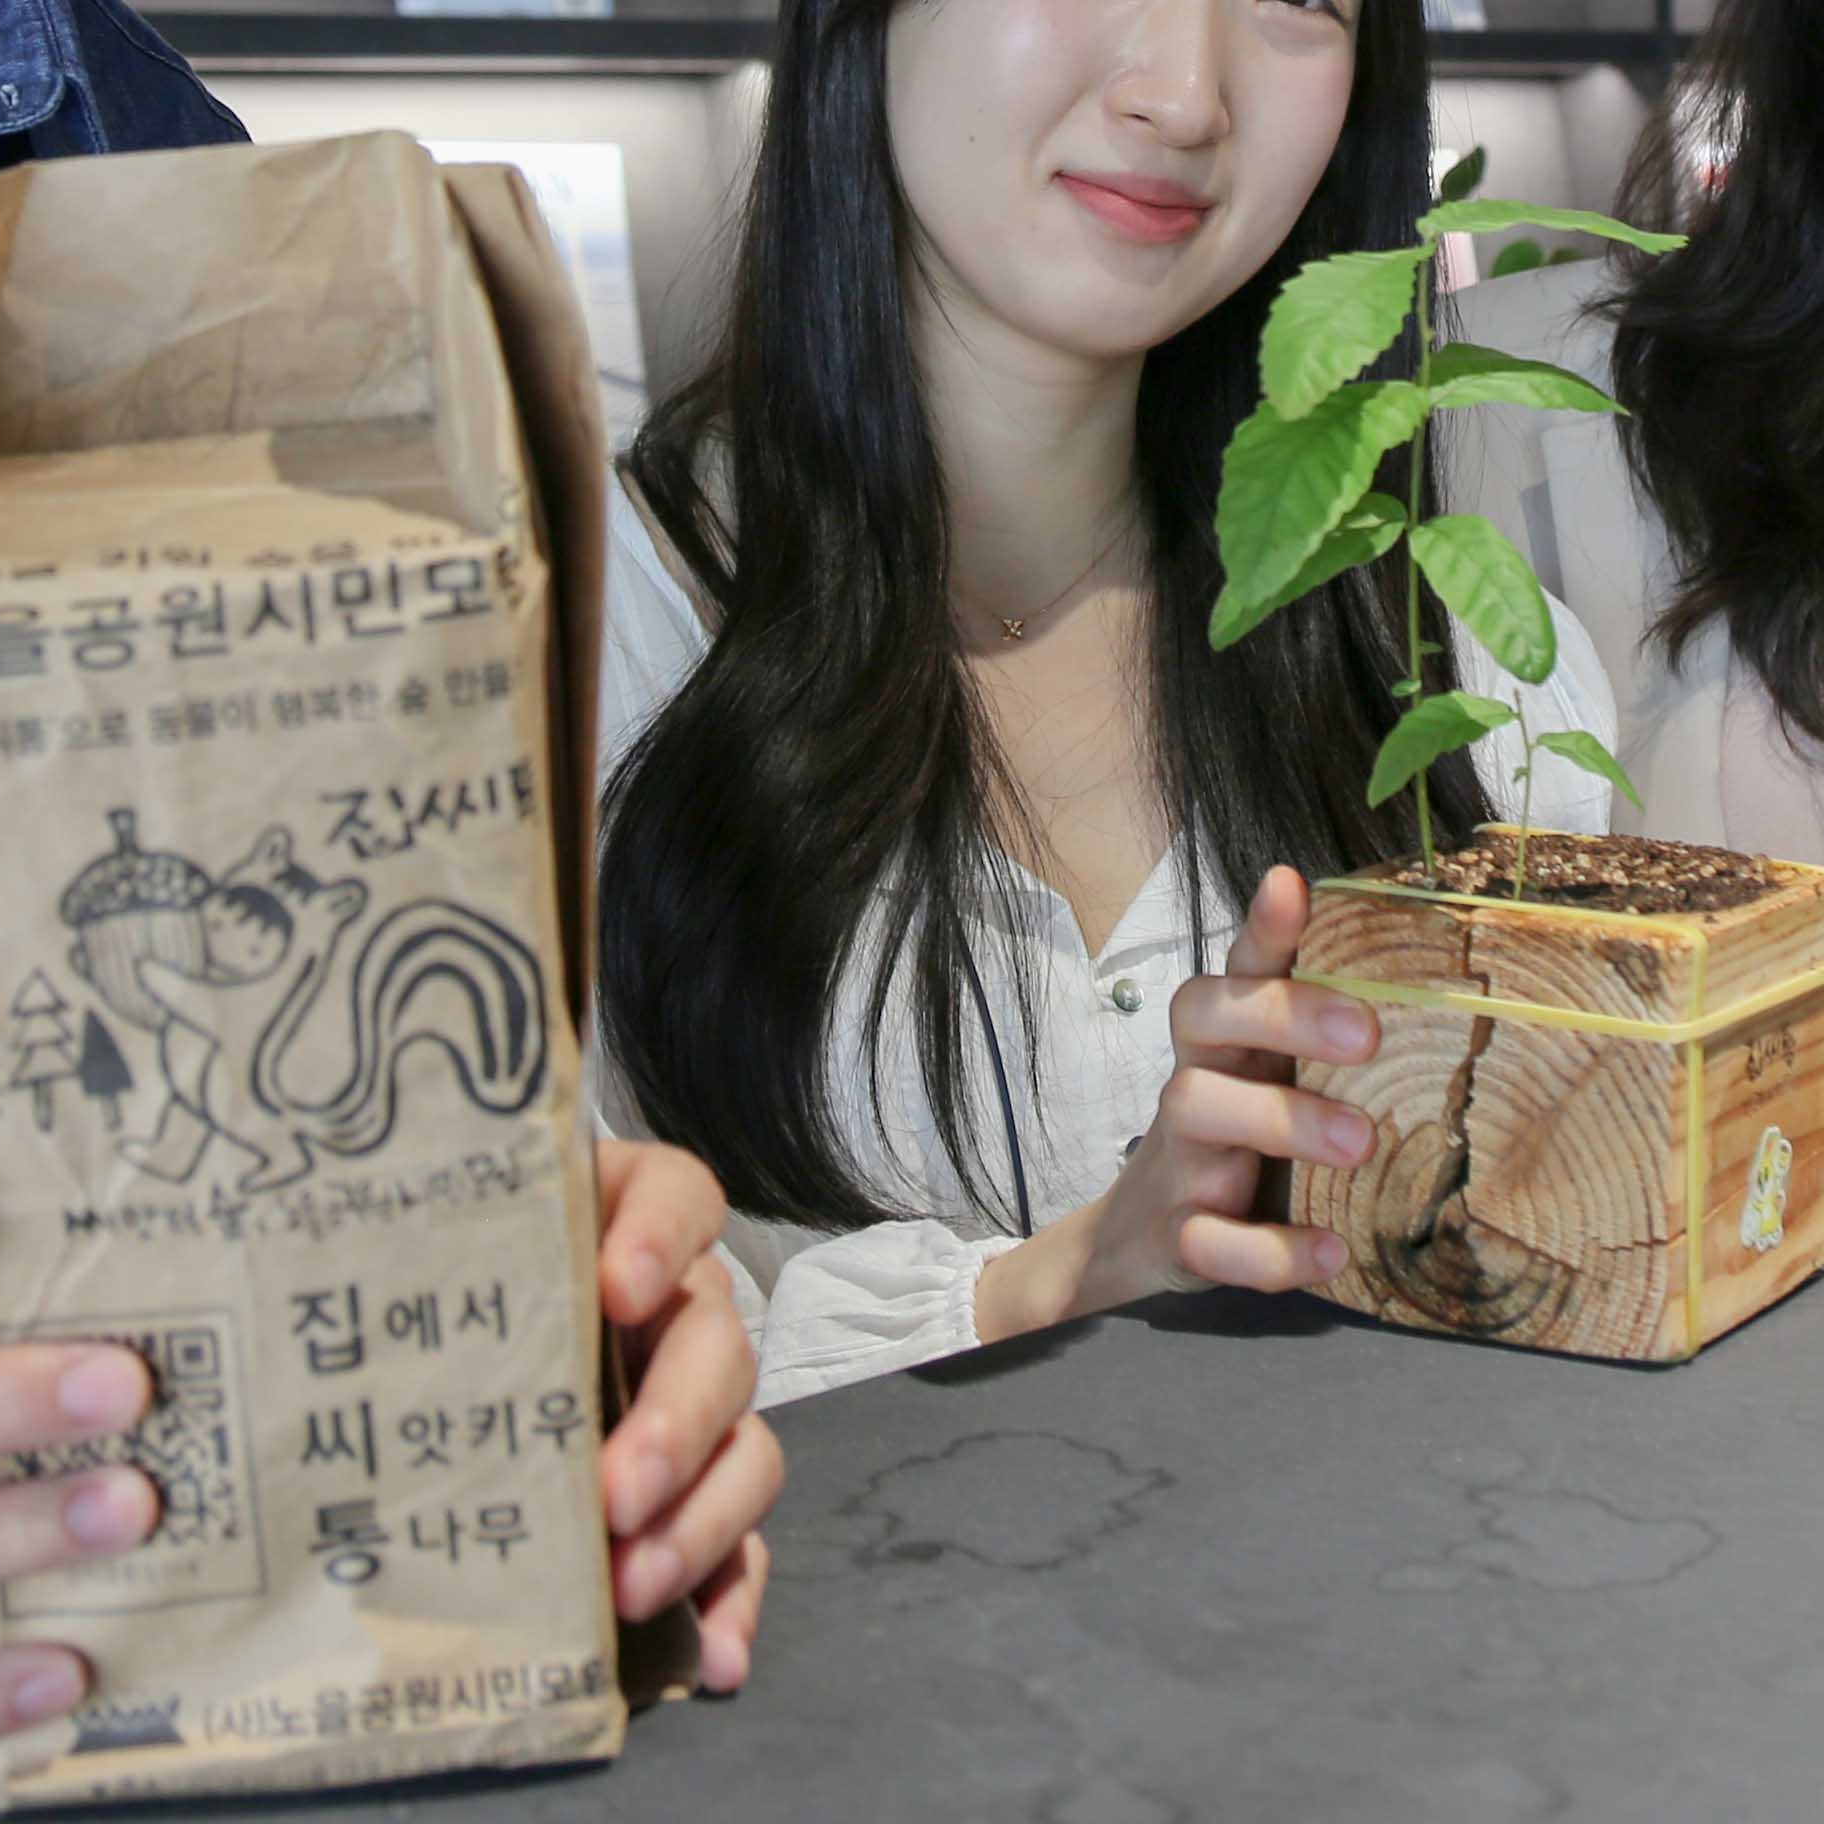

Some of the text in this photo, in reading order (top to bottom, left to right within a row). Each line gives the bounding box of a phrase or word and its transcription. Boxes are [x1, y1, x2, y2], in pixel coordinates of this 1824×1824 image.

[289, 1279, 509, 1376] 집에서
[300, 1391, 586, 1479] 씨앗키우
[307, 1498, 530, 1587] 통나무
